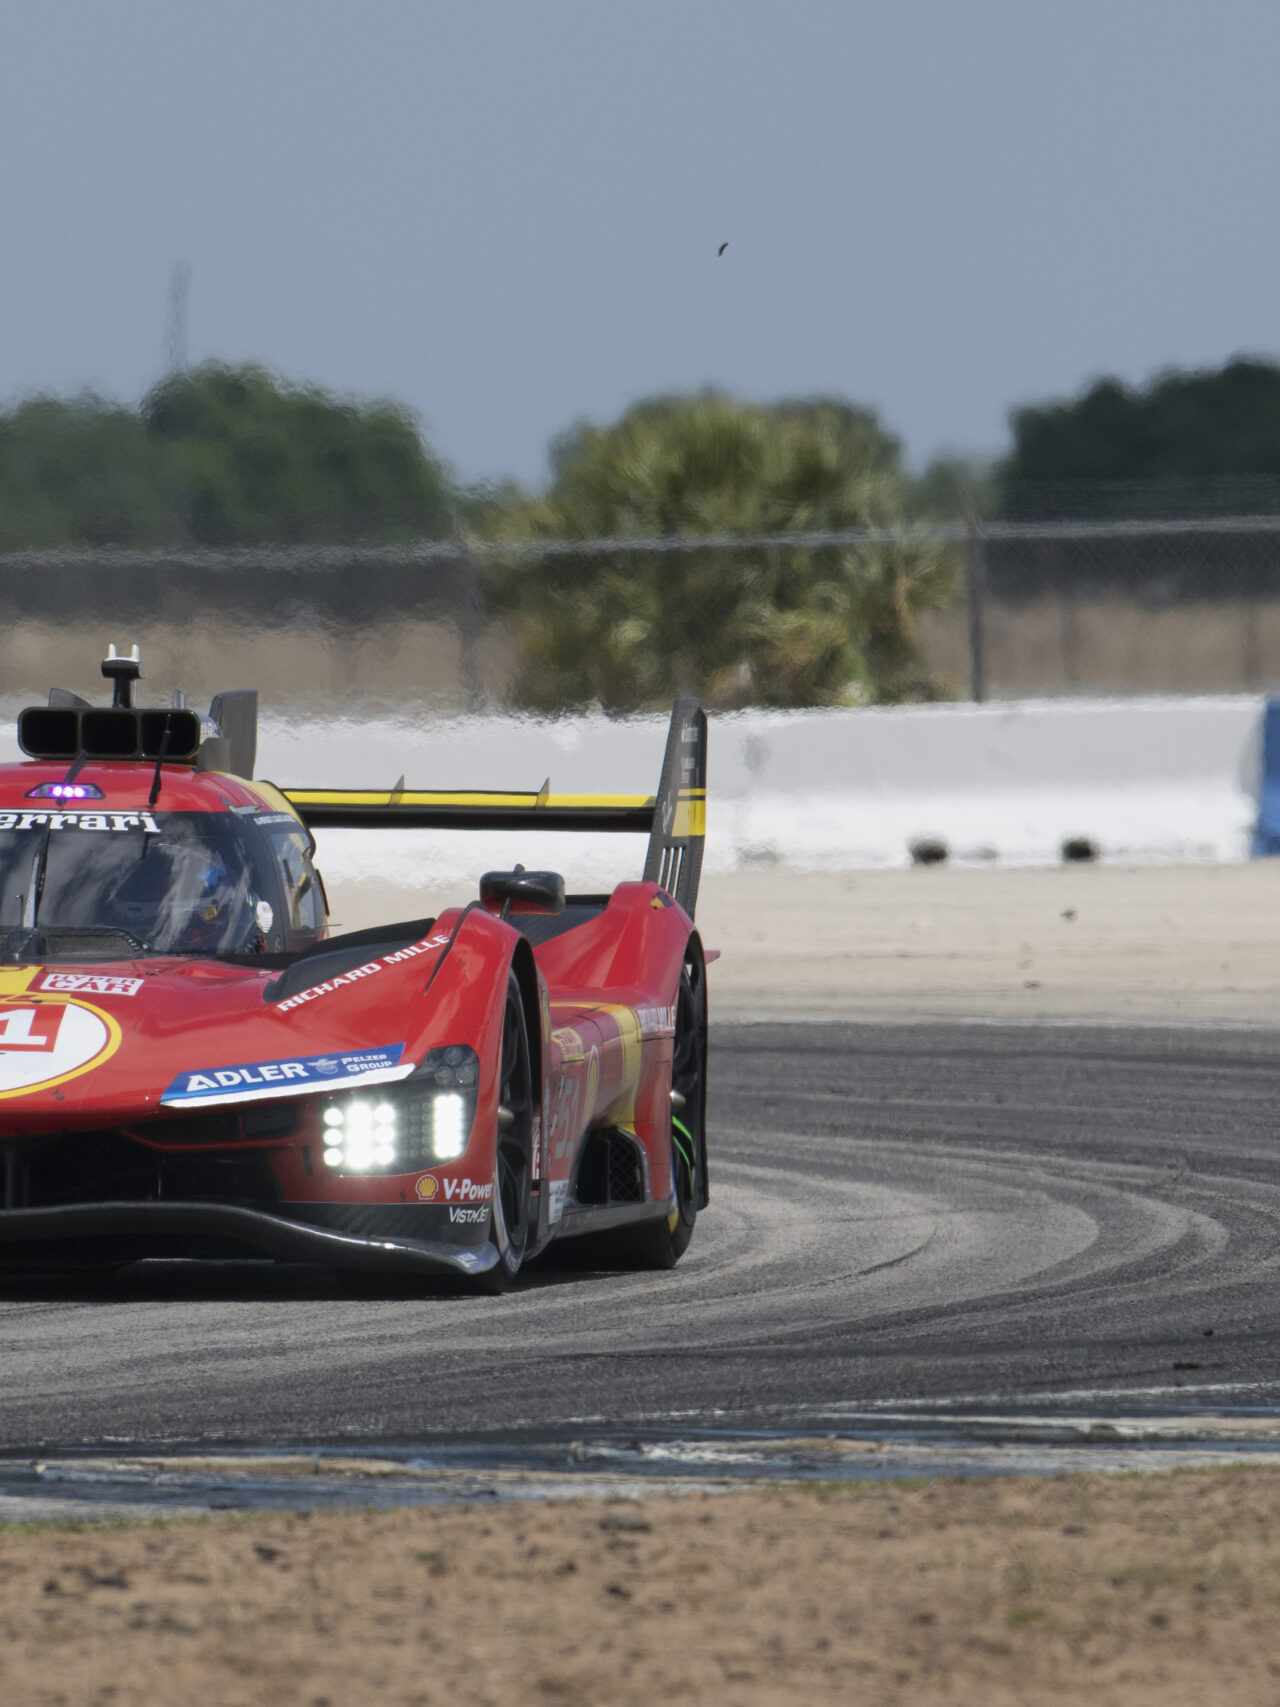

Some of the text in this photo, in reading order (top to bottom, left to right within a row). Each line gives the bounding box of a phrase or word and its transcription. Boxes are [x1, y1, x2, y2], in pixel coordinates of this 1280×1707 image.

[48, 980, 133, 993] CAR
[276, 934, 450, 1012] RICHARD MILLE
[186, 1062, 309, 1092] ADLER
